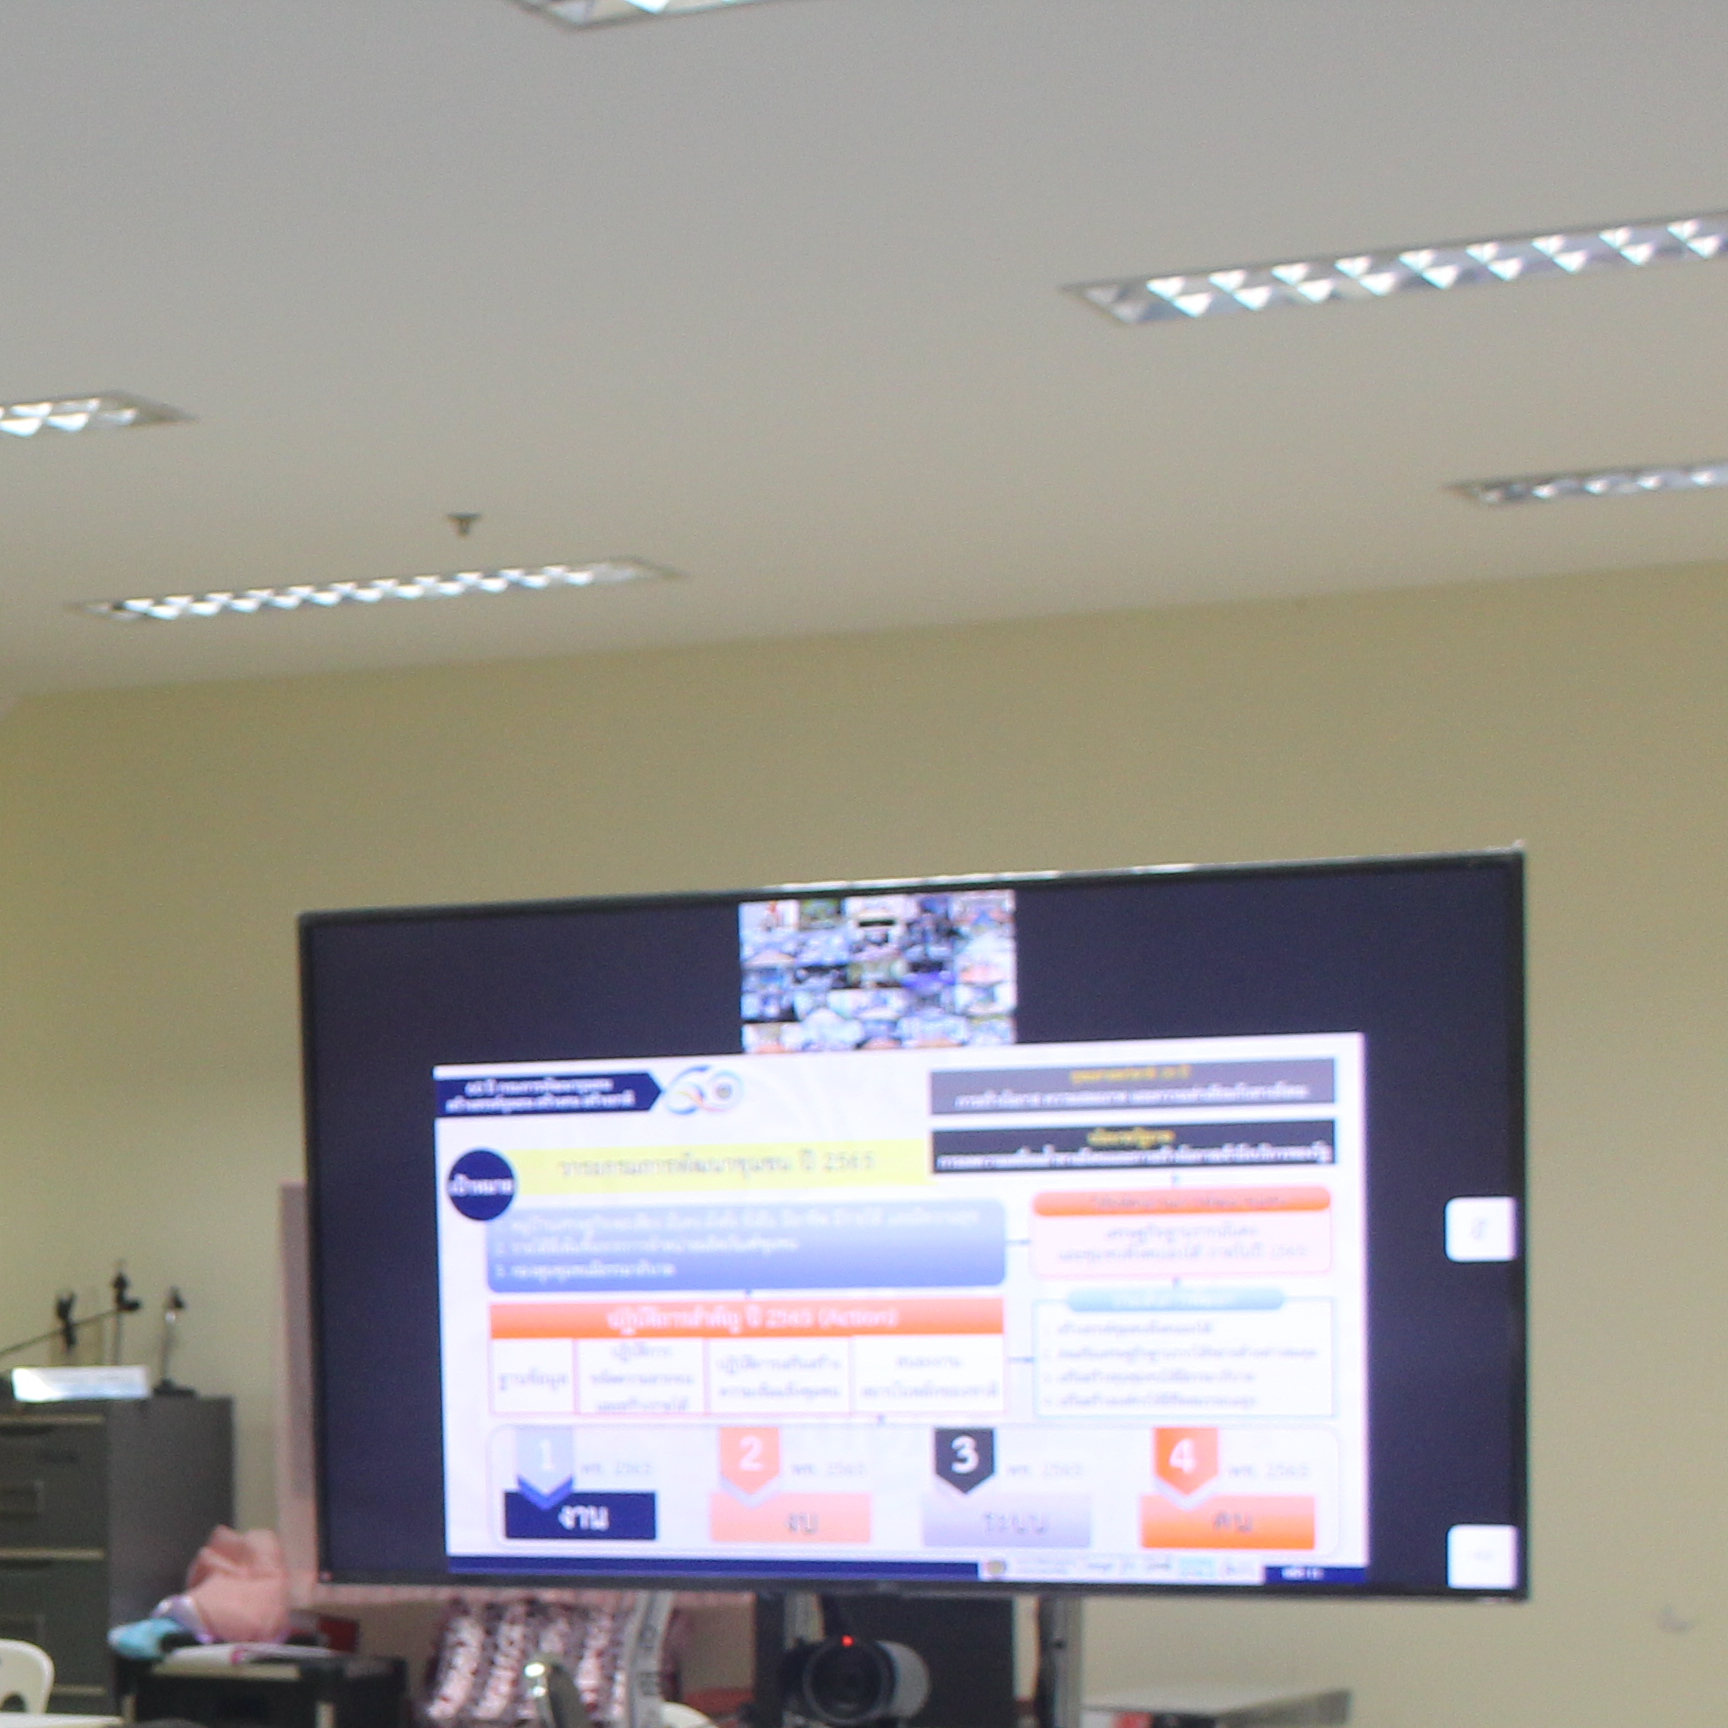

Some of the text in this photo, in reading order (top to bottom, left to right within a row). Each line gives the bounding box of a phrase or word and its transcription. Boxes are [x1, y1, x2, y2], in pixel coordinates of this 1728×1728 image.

[537, 1439, 555, 1472] 1
[738, 1435, 765, 1472] 2
[950, 1435, 980, 1475] 3
[1168, 1437, 1197, 1475] 4
[558, 1505, 610, 1533] งาน
